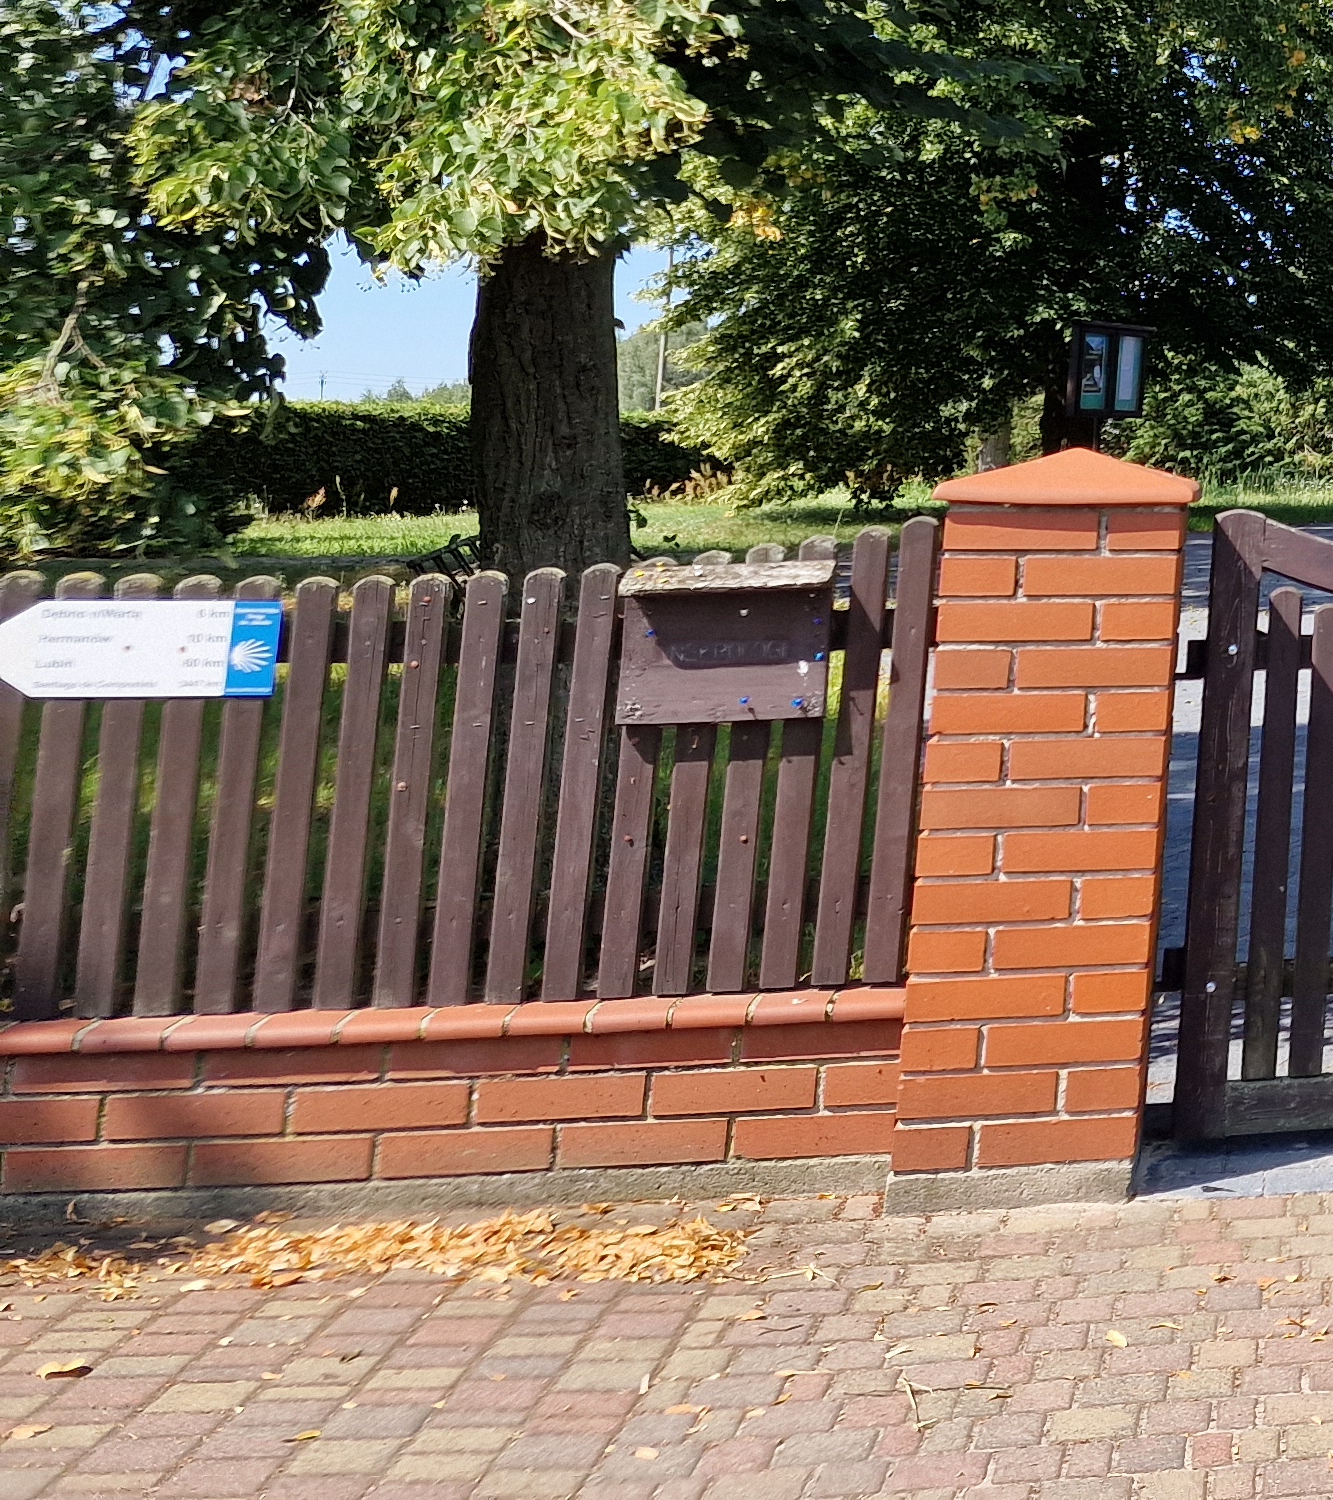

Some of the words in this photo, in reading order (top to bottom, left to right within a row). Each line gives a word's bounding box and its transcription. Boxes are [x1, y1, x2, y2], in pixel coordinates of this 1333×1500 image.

[209, 608, 230, 618] km
[206, 633, 228, 643] km
[202, 658, 224, 668] km
